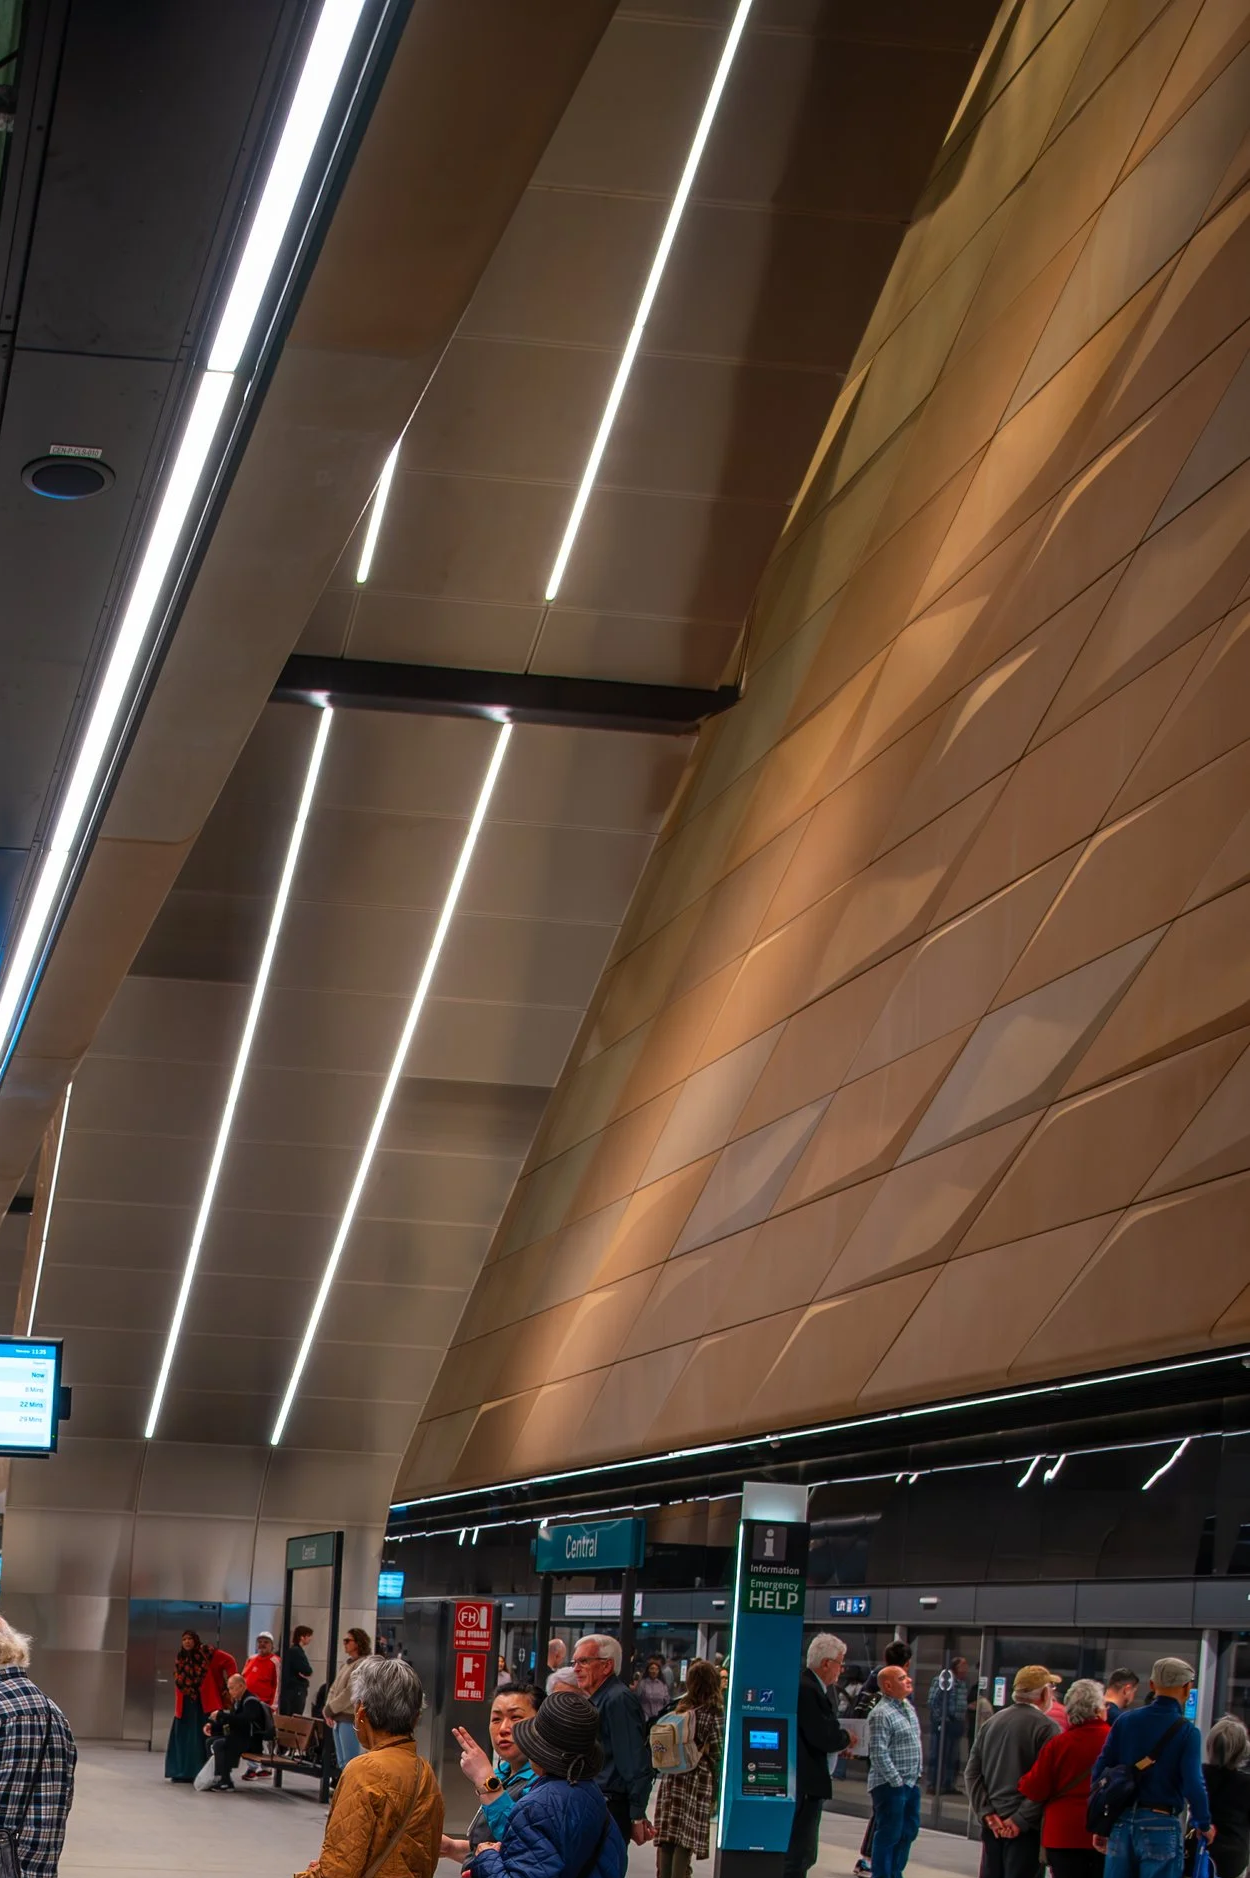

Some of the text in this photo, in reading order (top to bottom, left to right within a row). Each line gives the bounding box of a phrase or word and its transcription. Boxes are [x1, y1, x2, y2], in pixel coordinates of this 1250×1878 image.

[565, 1530, 598, 1559] Central
[750, 1564, 800, 1575] Information
[750, 1579, 799, 1592] Emergency
[749, 1590, 799, 1610] HELP
[836, 1600, 846, 1611] Lift
[461, 1612, 476, 1623] FH
[464, 1681, 476, 1689] FIRE
[470, 1690, 482, 1698] REEL
[741, 1704, 775, 1712] Information
